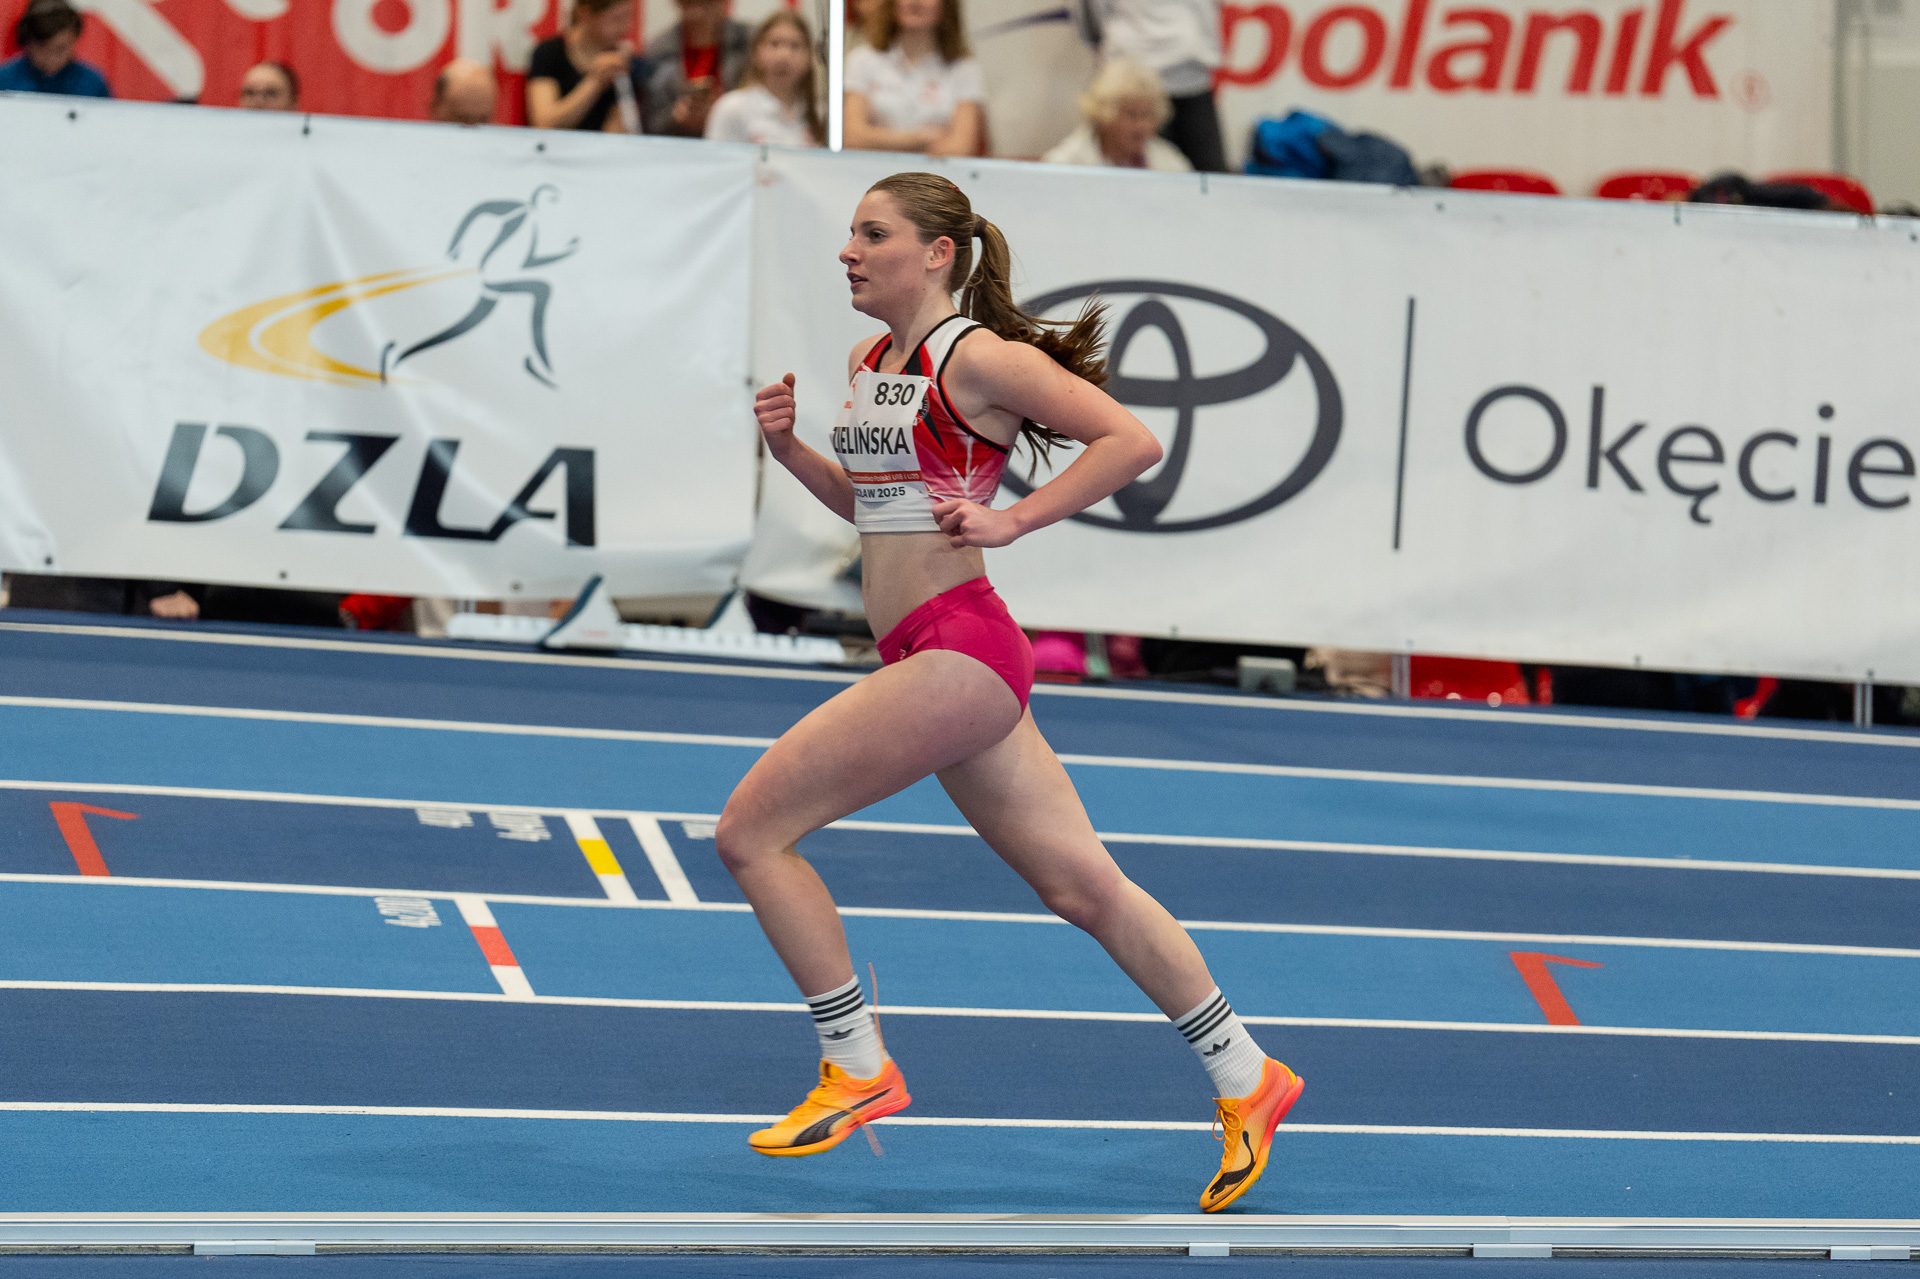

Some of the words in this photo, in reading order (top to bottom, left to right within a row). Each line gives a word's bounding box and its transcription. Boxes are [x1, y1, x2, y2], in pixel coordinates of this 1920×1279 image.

[1214, 0, 1735, 98] polanik
[874, 381, 916, 406] 830
[147, 421, 596, 547] DZLA
[877, 486, 906, 498] 2025
[1463, 383, 1917, 525] Okęcie
